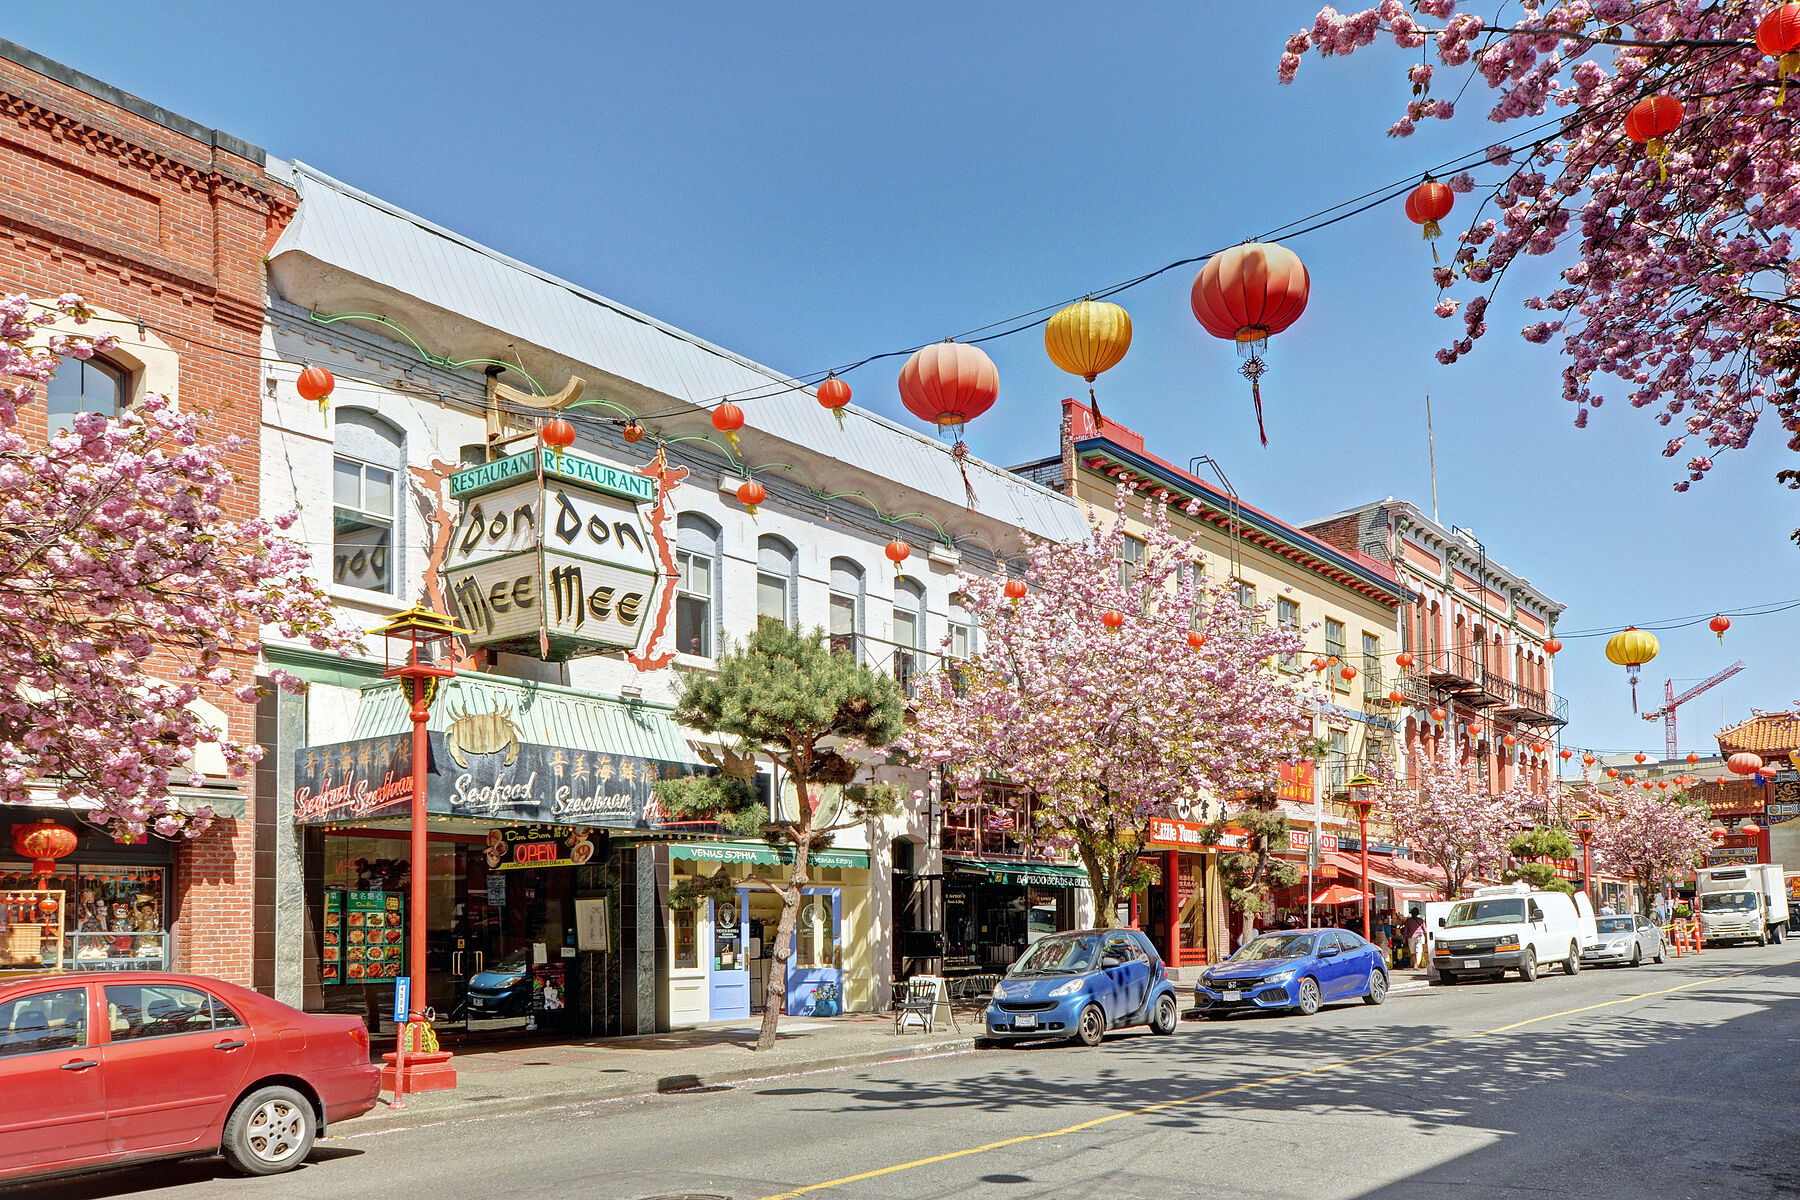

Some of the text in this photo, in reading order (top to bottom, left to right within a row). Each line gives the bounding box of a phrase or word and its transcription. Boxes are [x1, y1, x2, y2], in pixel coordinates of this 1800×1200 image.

[451, 452, 537, 493] RESTAURANT
[545, 452, 650, 496] RESTAURANT
[459, 503, 535, 557] Don
[555, 489, 644, 553] Don
[293, 770, 353, 820] Seafood
[450, 771, 538, 816] Seafood
[551, 785, 634, 818] Szechuan
[505, 830, 526, 841] Dim
[528, 828, 551, 840] Sum
[1153, 820, 1177, 841] Little
[1177, 823, 1200, 844] Yunn
[1293, 832, 1335, 848] SEAOD
[516, 843, 558, 862] OPEN
[690, 848, 722, 859] VENUS
[725, 849, 758, 861] SOPHIA
[1016, 874, 1046, 885] BAMBOO
[1046, 876, 1068, 886] BEADS
[1068, 877, 1075, 887] &
